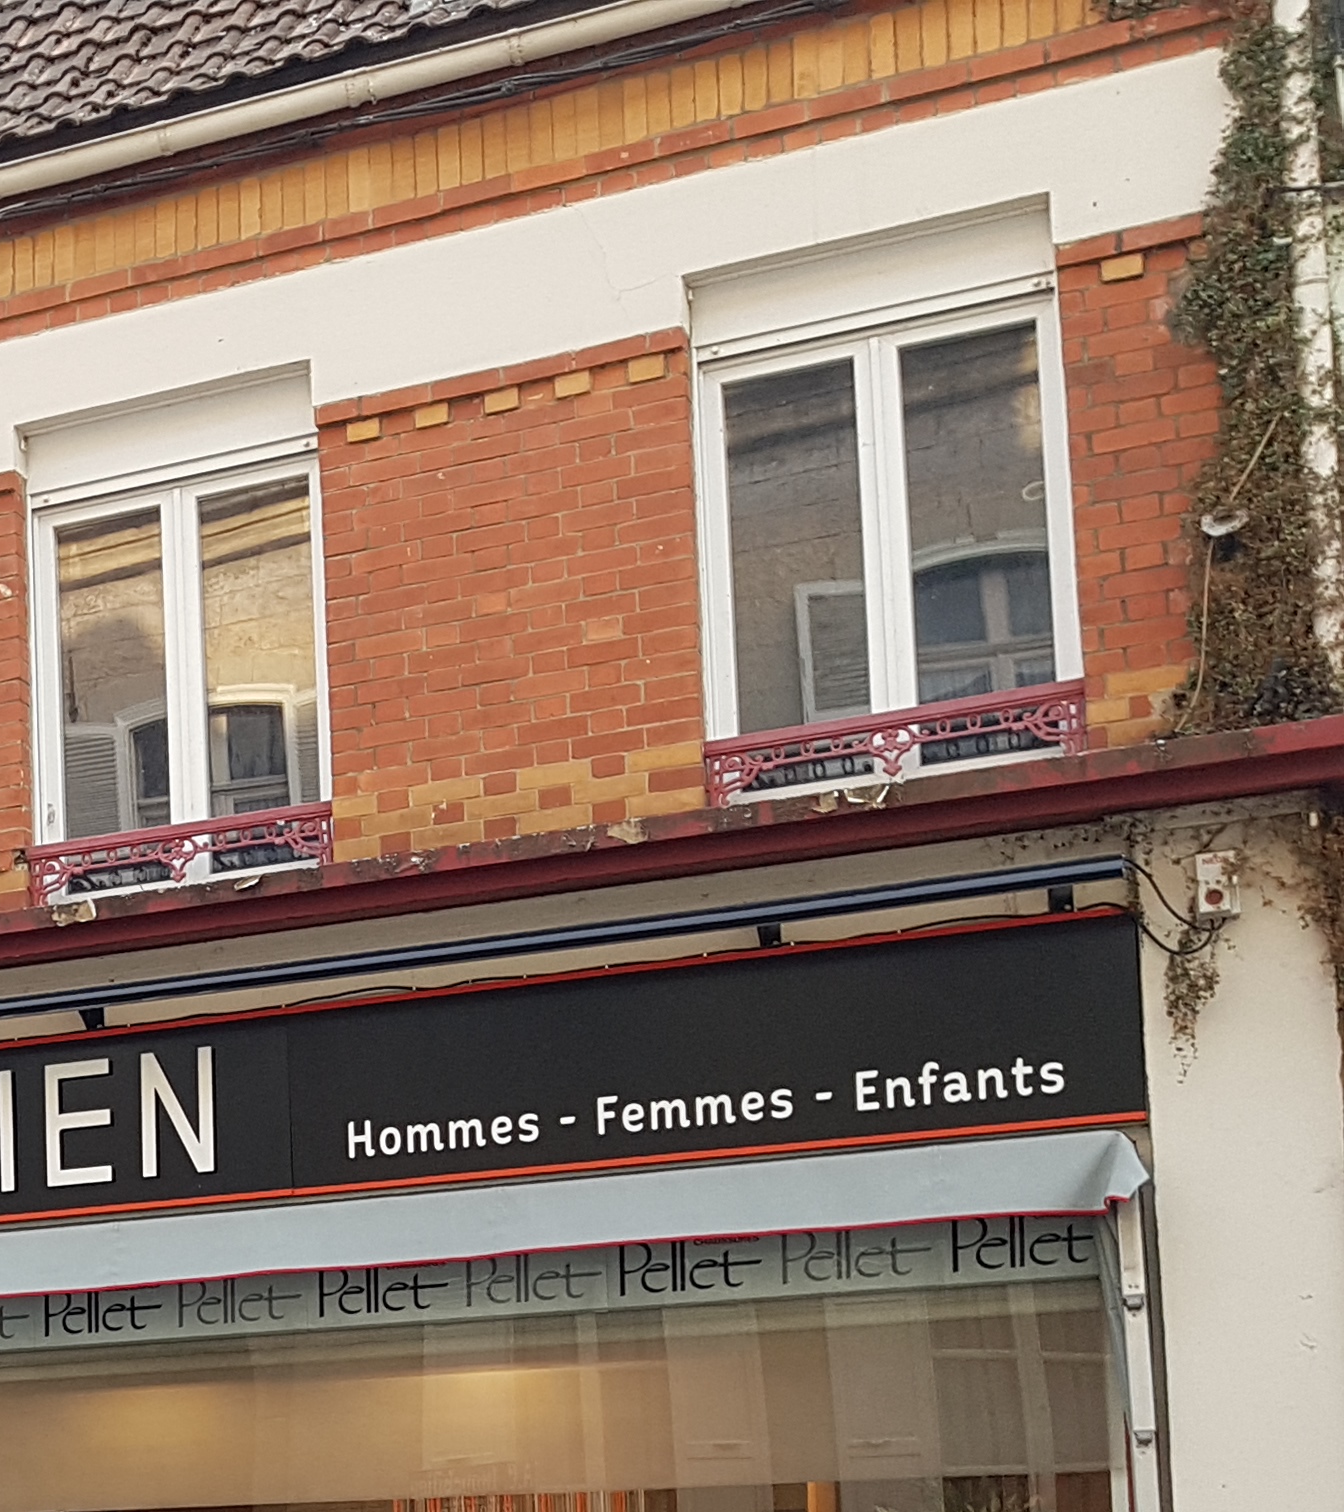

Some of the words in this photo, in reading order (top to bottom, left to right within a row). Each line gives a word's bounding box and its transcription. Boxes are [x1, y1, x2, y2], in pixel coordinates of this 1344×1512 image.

[347, 1110, 541, 1160] Hommes
[596, 1084, 795, 1136] Femmes
[854, 1056, 1066, 1113] Enfants
[44, 1291, 162, 1337] Pellet
[178, 1279, 302, 1328] Pellet
[318, 1268, 450, 1317] Pellet
[465, 1253, 603, 1307] Pellet
[618, 1240, 762, 1297] Pellet
[780, 1230, 932, 1285] Pellet
[951, 1216, 1094, 1272] Pellet
